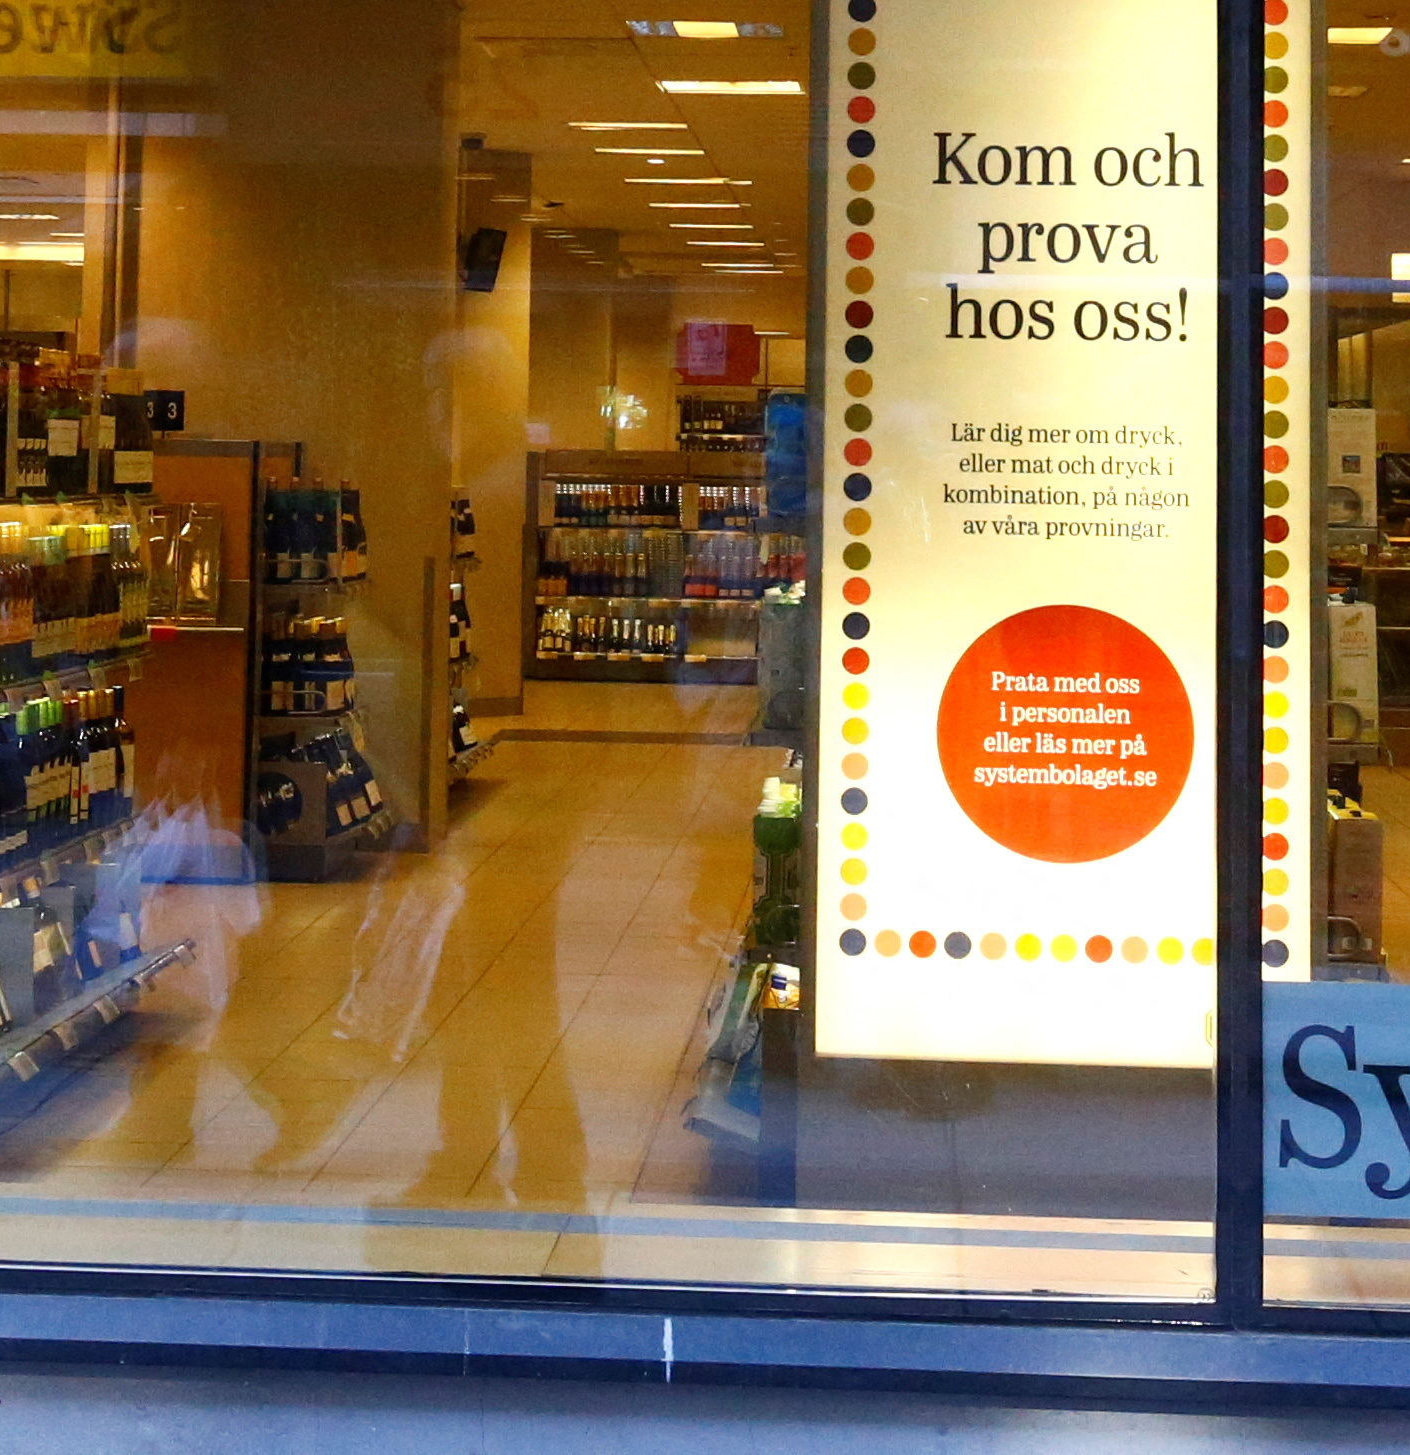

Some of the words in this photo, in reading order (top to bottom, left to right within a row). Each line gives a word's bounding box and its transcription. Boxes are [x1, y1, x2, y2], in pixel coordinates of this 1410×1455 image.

[932, 132, 1076, 187] Kom
[1094, 133, 1204, 188] och
[978, 221, 1158, 273] prova
[945, 283, 1055, 340] hos
[1073, 287, 1189, 342] oss!
[146, 401, 154, 419] 3
[167, 401, 177, 420] 3
[951, 423, 986, 443] Lär
[990, 423, 1023, 447] dig
[1027, 428, 1071, 444] mer
[1075, 429, 1109, 445] om
[1115, 426, 1183, 449] dryck,
[959, 454, 1005, 473] eller
[1010, 456, 1053, 474] mat
[1057, 455, 1095, 475] och
[1101, 456, 1162, 480] dryck
[1167, 458, 1174, 477] i
[943, 484, 1087, 507] kombination,
[1093, 485, 1118, 510] på
[1125, 487, 1190, 511] någon
[963, 520, 987, 535] av
[992, 514, 1040, 536] våra
[1045, 518, 1169, 542] provningar.
[991, 671, 1049, 692] Prata
[1053, 672, 1101, 694] med
[1105, 677, 1140, 695] oss
[999, 701, 1007, 722] i
[1012, 702, 1131, 726] personalen
[983, 731, 1032, 753] eller
[1036, 732, 1067, 754] läs
[1071, 738, 1116, 755] mer
[1120, 733, 1147, 759] på
[973, 763, 1157, 790] systembolaget.se
